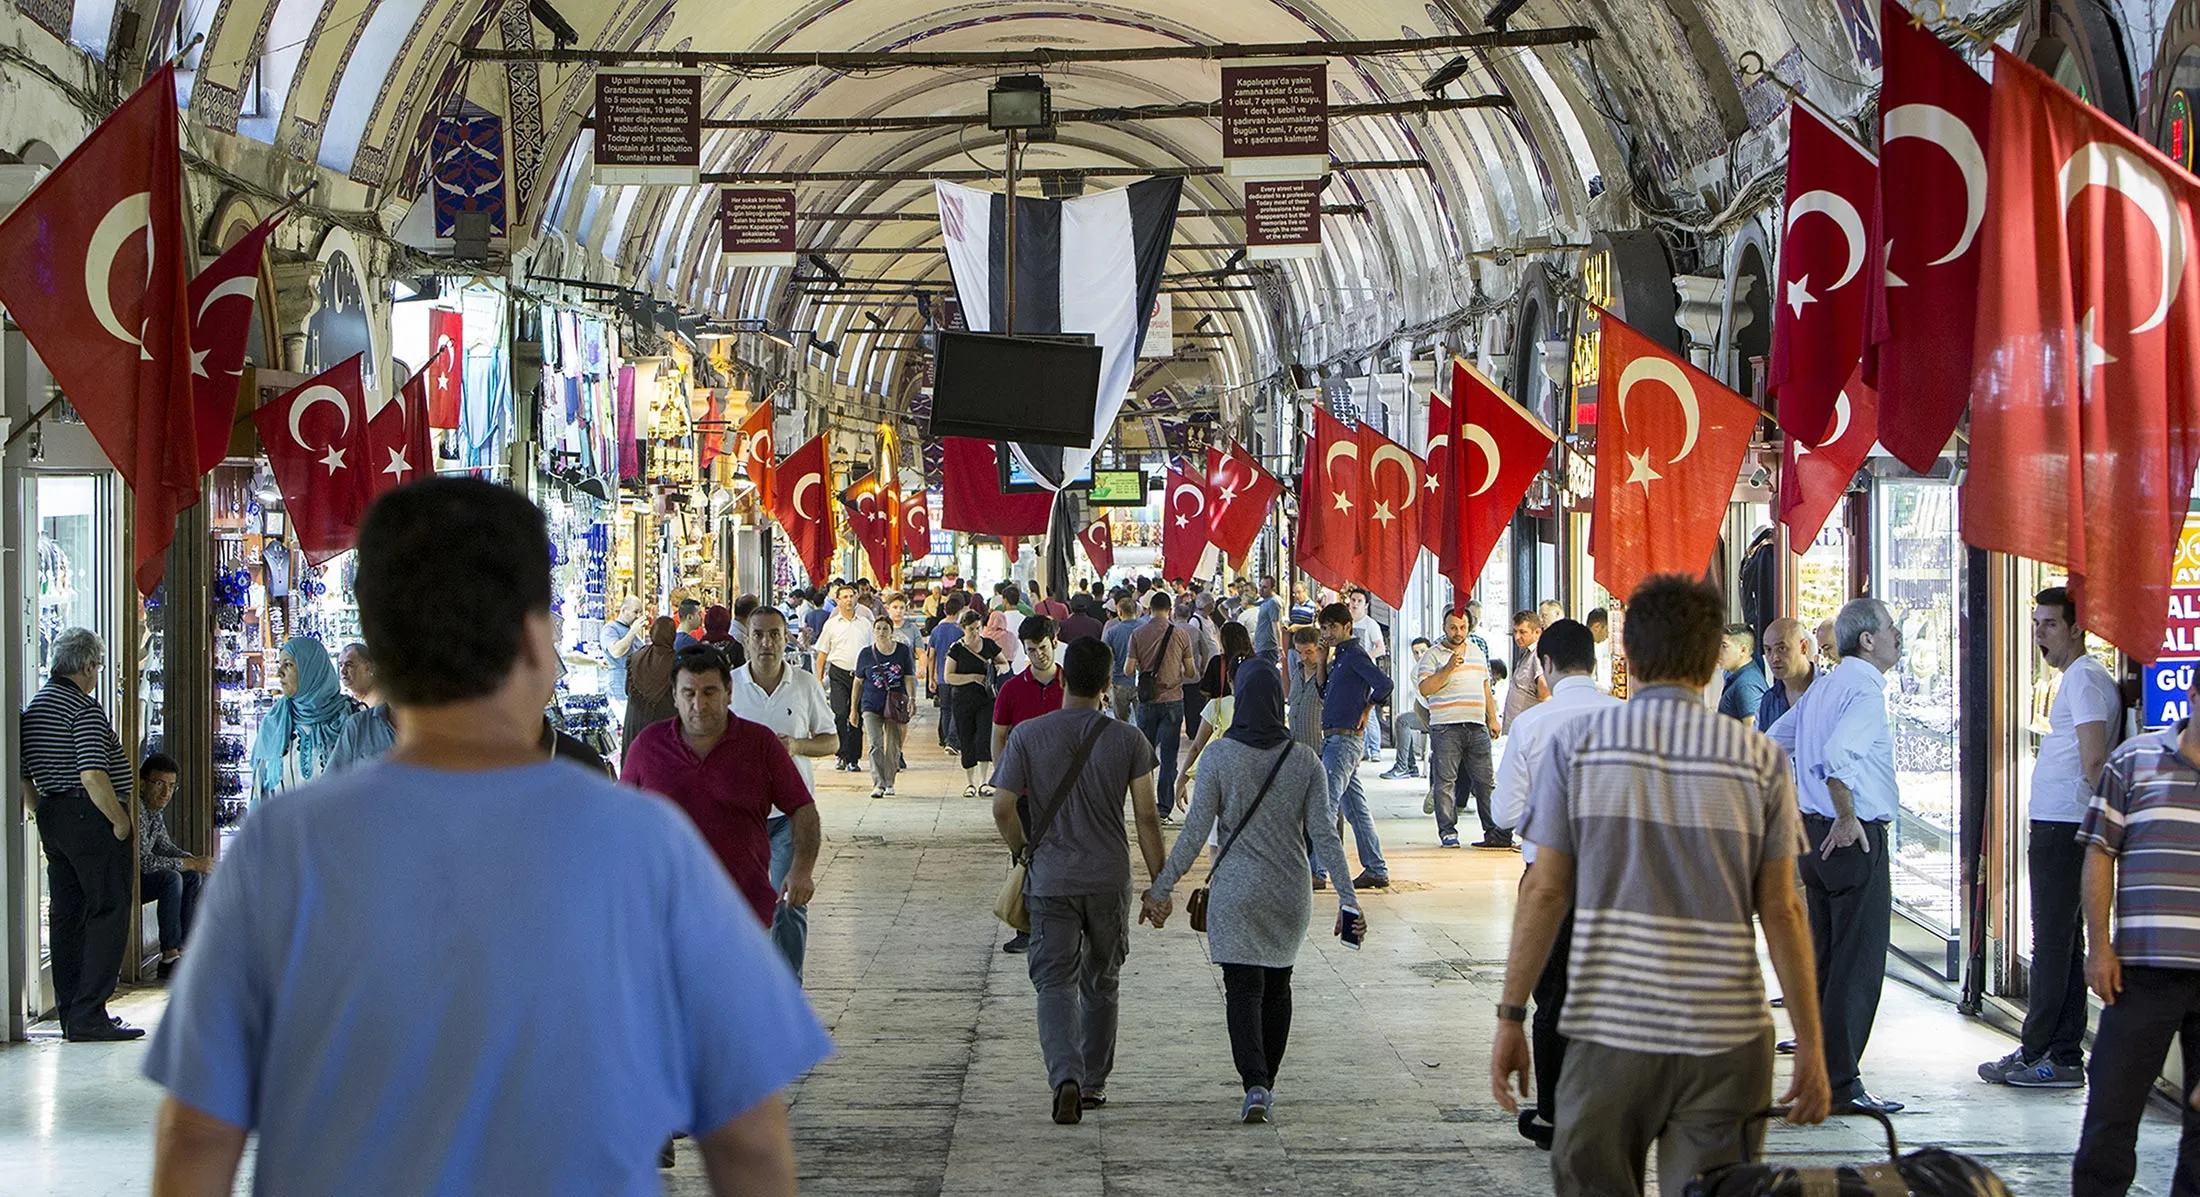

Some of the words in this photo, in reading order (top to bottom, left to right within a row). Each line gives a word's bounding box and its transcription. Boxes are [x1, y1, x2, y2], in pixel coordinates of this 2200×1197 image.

[612, 77, 622, 86] Up
[642, 77, 672, 86] recently
[1291, 77, 1311, 86] yakın
[604, 86, 626, 94] Grand
[629, 86, 654, 94] Bazaar
[672, 87, 693, 95] home
[1294, 86, 1314, 94] cami,
[605, 96, 612, 104] to
[614, 96, 619, 104] 5
[664, 97, 692, 105] school,
[1235, 98, 1253, 106] okul,
[1290, 96, 1299, 104] 10
[616, 106, 653, 114] fountains,
[665, 107, 686, 115] wells,
[1251, 107, 1270, 115] dere,
[1278, 106, 1296, 114] sebil
[636, 116, 672, 124] dispenser
[1233, 117, 1266, 126] şadırvan
[618, 125, 648, 133] ablution
[1233, 127, 1258, 136] Bugün
[1266, 126, 1286, 134] cami,
[1288, 125, 1292, 133] 7
[1294, 126, 1319, 134] çeşme
[607, 134, 630, 143] Today
[631, 135, 647, 143] only
[1251, 136, 1283, 145] şadırvan
[608, 144, 638, 152] fountain
[617, 154, 648, 162] fountain
